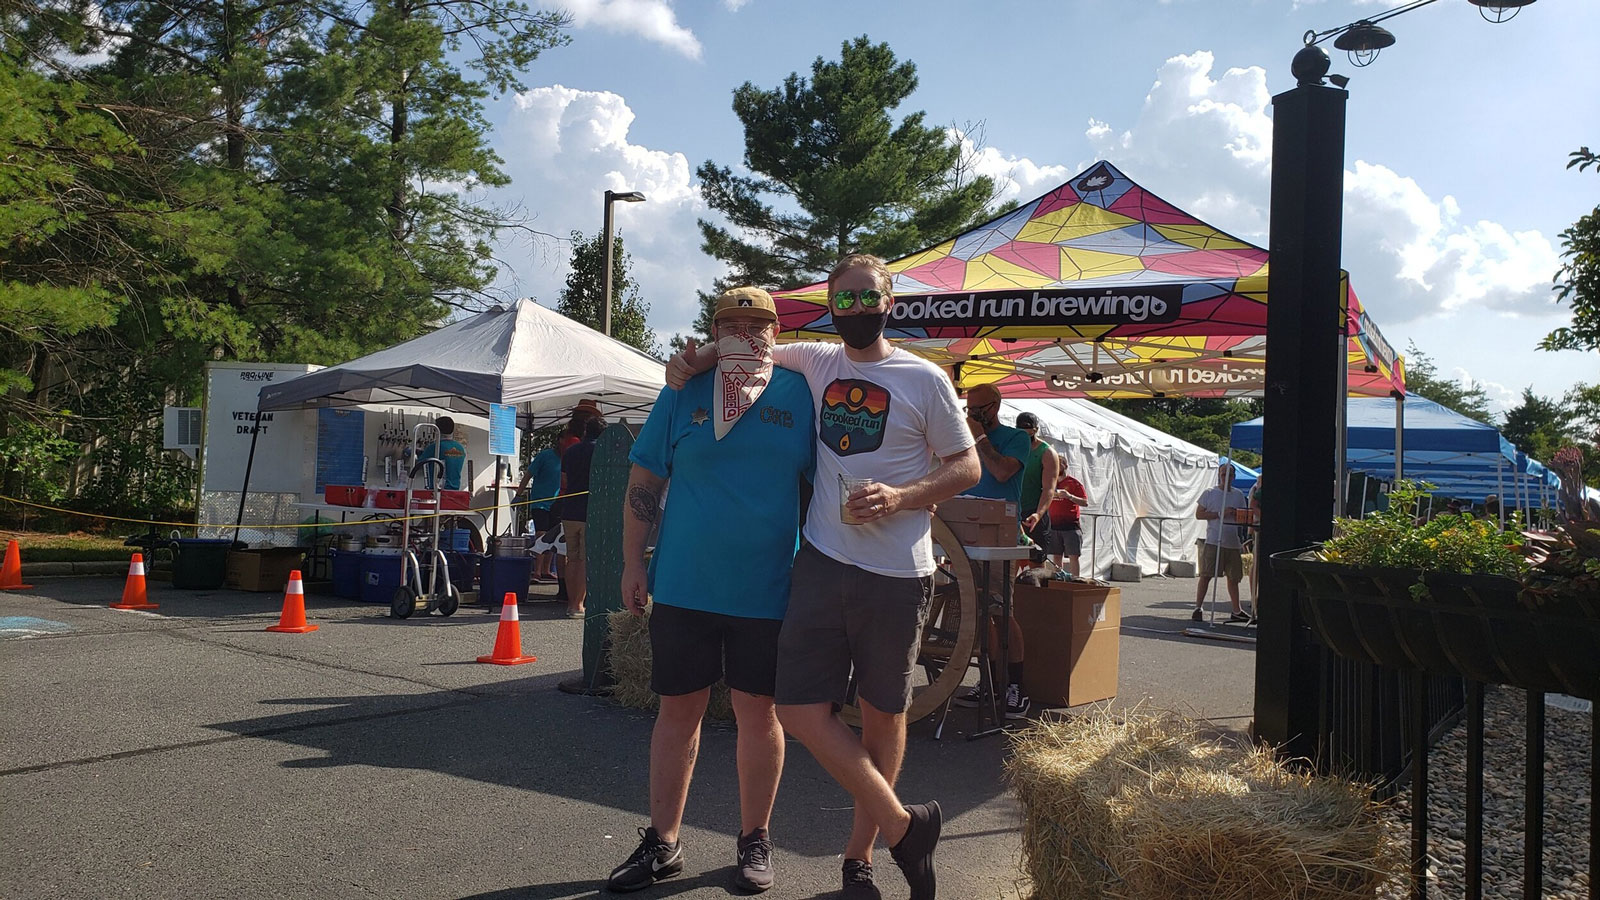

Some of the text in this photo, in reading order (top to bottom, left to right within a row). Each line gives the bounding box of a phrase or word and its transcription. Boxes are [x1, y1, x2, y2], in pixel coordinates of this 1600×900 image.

[892, 290, 1151, 322] ooked run brewing
[232, 411, 274, 421] VETEAN
[823, 411, 880, 430] crooked run
